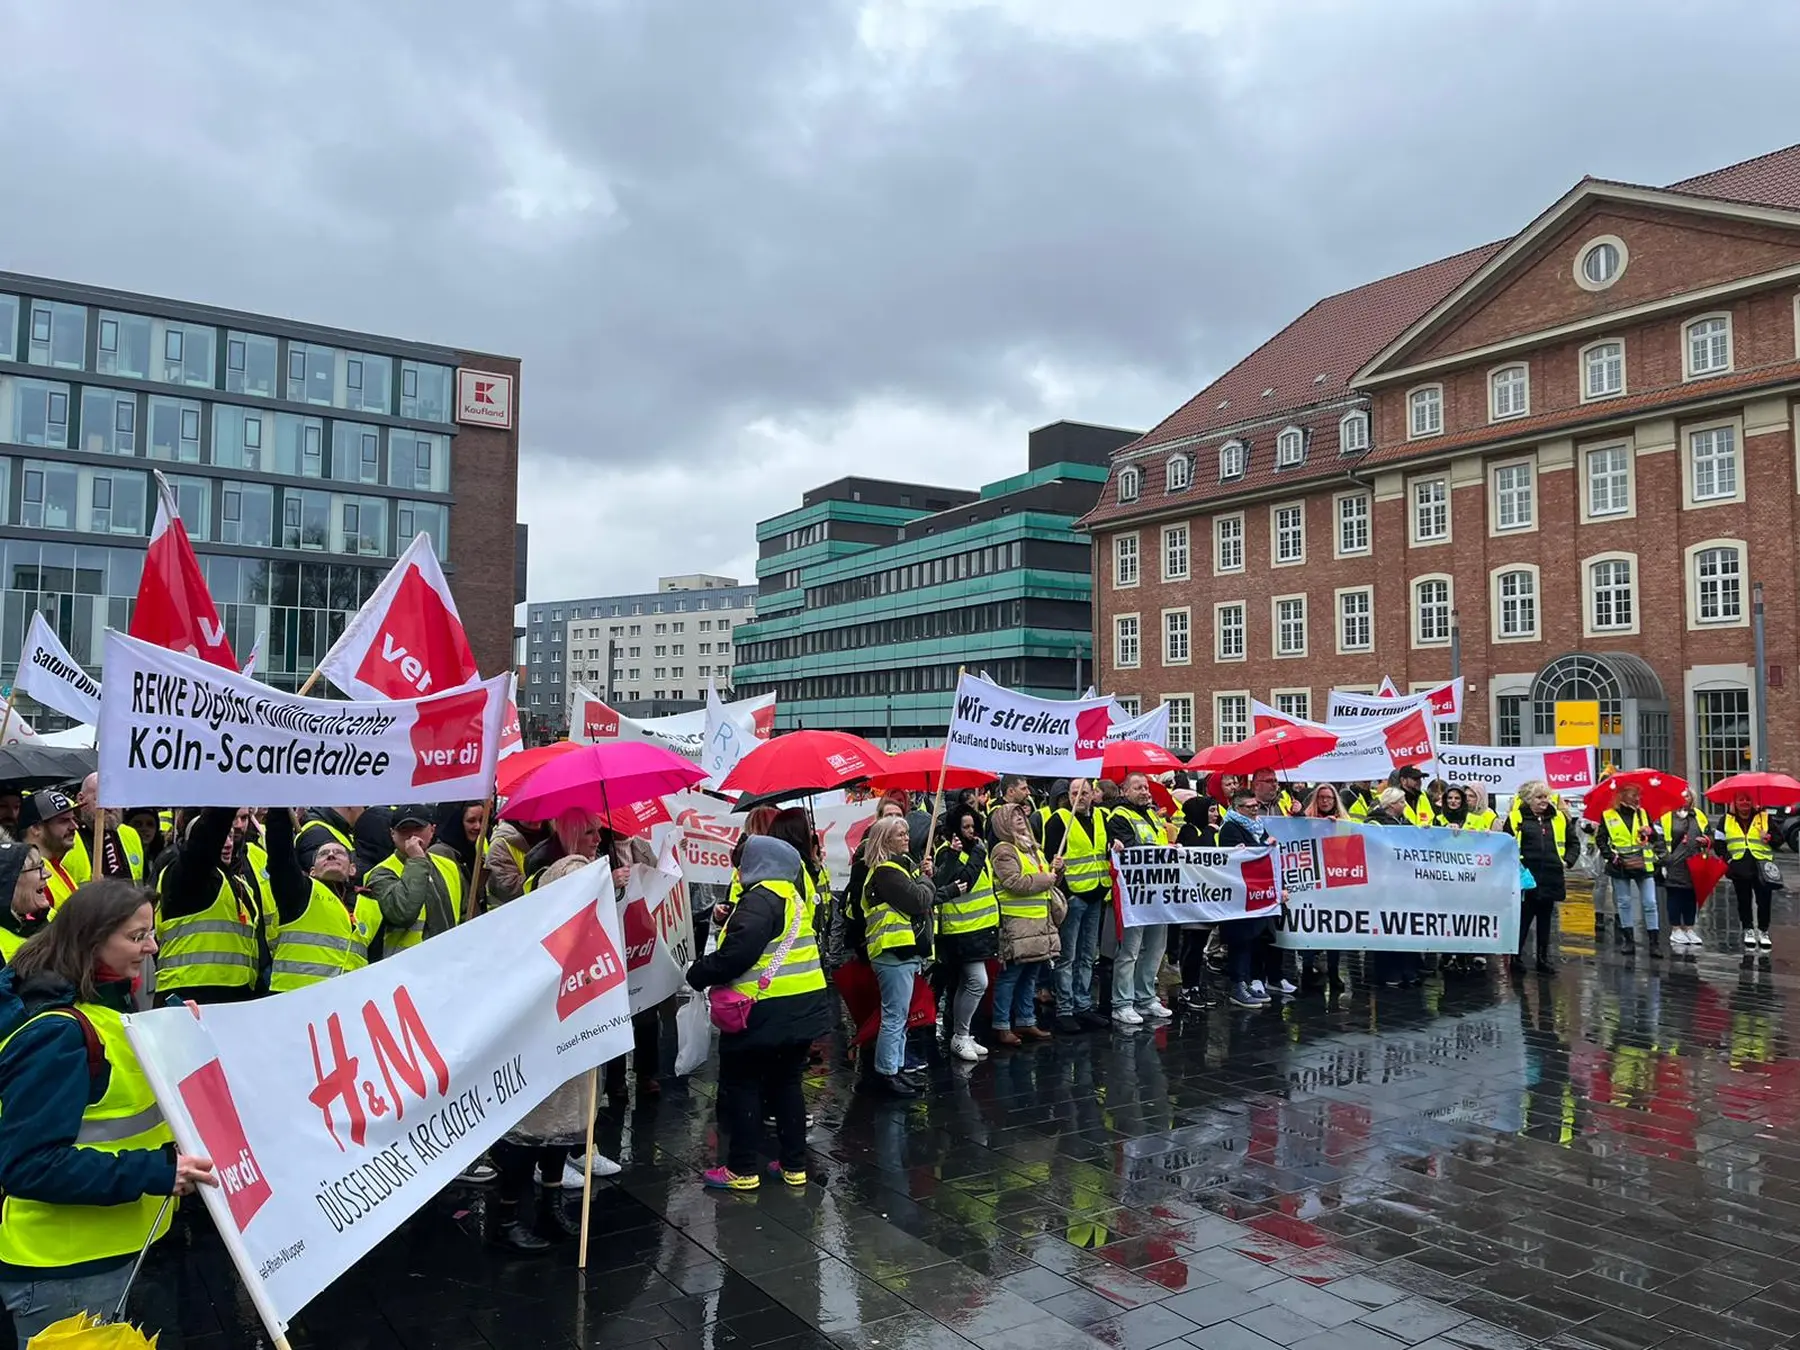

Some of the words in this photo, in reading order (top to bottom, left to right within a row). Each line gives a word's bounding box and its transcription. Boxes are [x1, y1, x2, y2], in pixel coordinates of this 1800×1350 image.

[465, 405, 504, 418] Kaufland
[381, 631, 433, 692] ver
[132, 671, 187, 716] REWE
[191, 682, 255, 730] Digital
[1333, 705, 1358, 717] IKEA
[957, 694, 990, 723] Wir
[990, 709, 1070, 736] streiken
[128, 726, 390, 777] Köln-Scarletallee
[951, 730, 989, 748] Kaufland
[991, 738, 1034, 757] Duisburg
[1391, 741, 1430, 757] ver.di
[419, 744, 478, 767] ver.di
[1437, 752, 1515, 767] Kaufland
[1448, 770, 1502, 783] Bottrop
[1549, 771, 1588, 782] ver.di
[1119, 848, 1229, 867] EDEKA-Lager
[1393, 848, 1475, 865] TARIFRUNDE
[1475, 854, 1492, 866] 23
[1327, 865, 1364, 878] ver.di
[1415, 868, 1455, 881] HANDEL
[1458, 871, 1477, 882] NRW
[1163, 883, 1233, 904] streiken
[560, 951, 617, 998] ver.di
[556, 1012, 632, 1055] Düssel-Rhein-Wup
[308, 984, 450, 1153] H&M
[315, 1140, 418, 1234] DÜSSELDORF
[407, 1085, 487, 1165] ARCADEN
[493, 1054, 528, 1105] BILK
[220, 1148, 259, 1196] ver.di
[258, 1237, 307, 1282] sel-Rhein-Wupper
